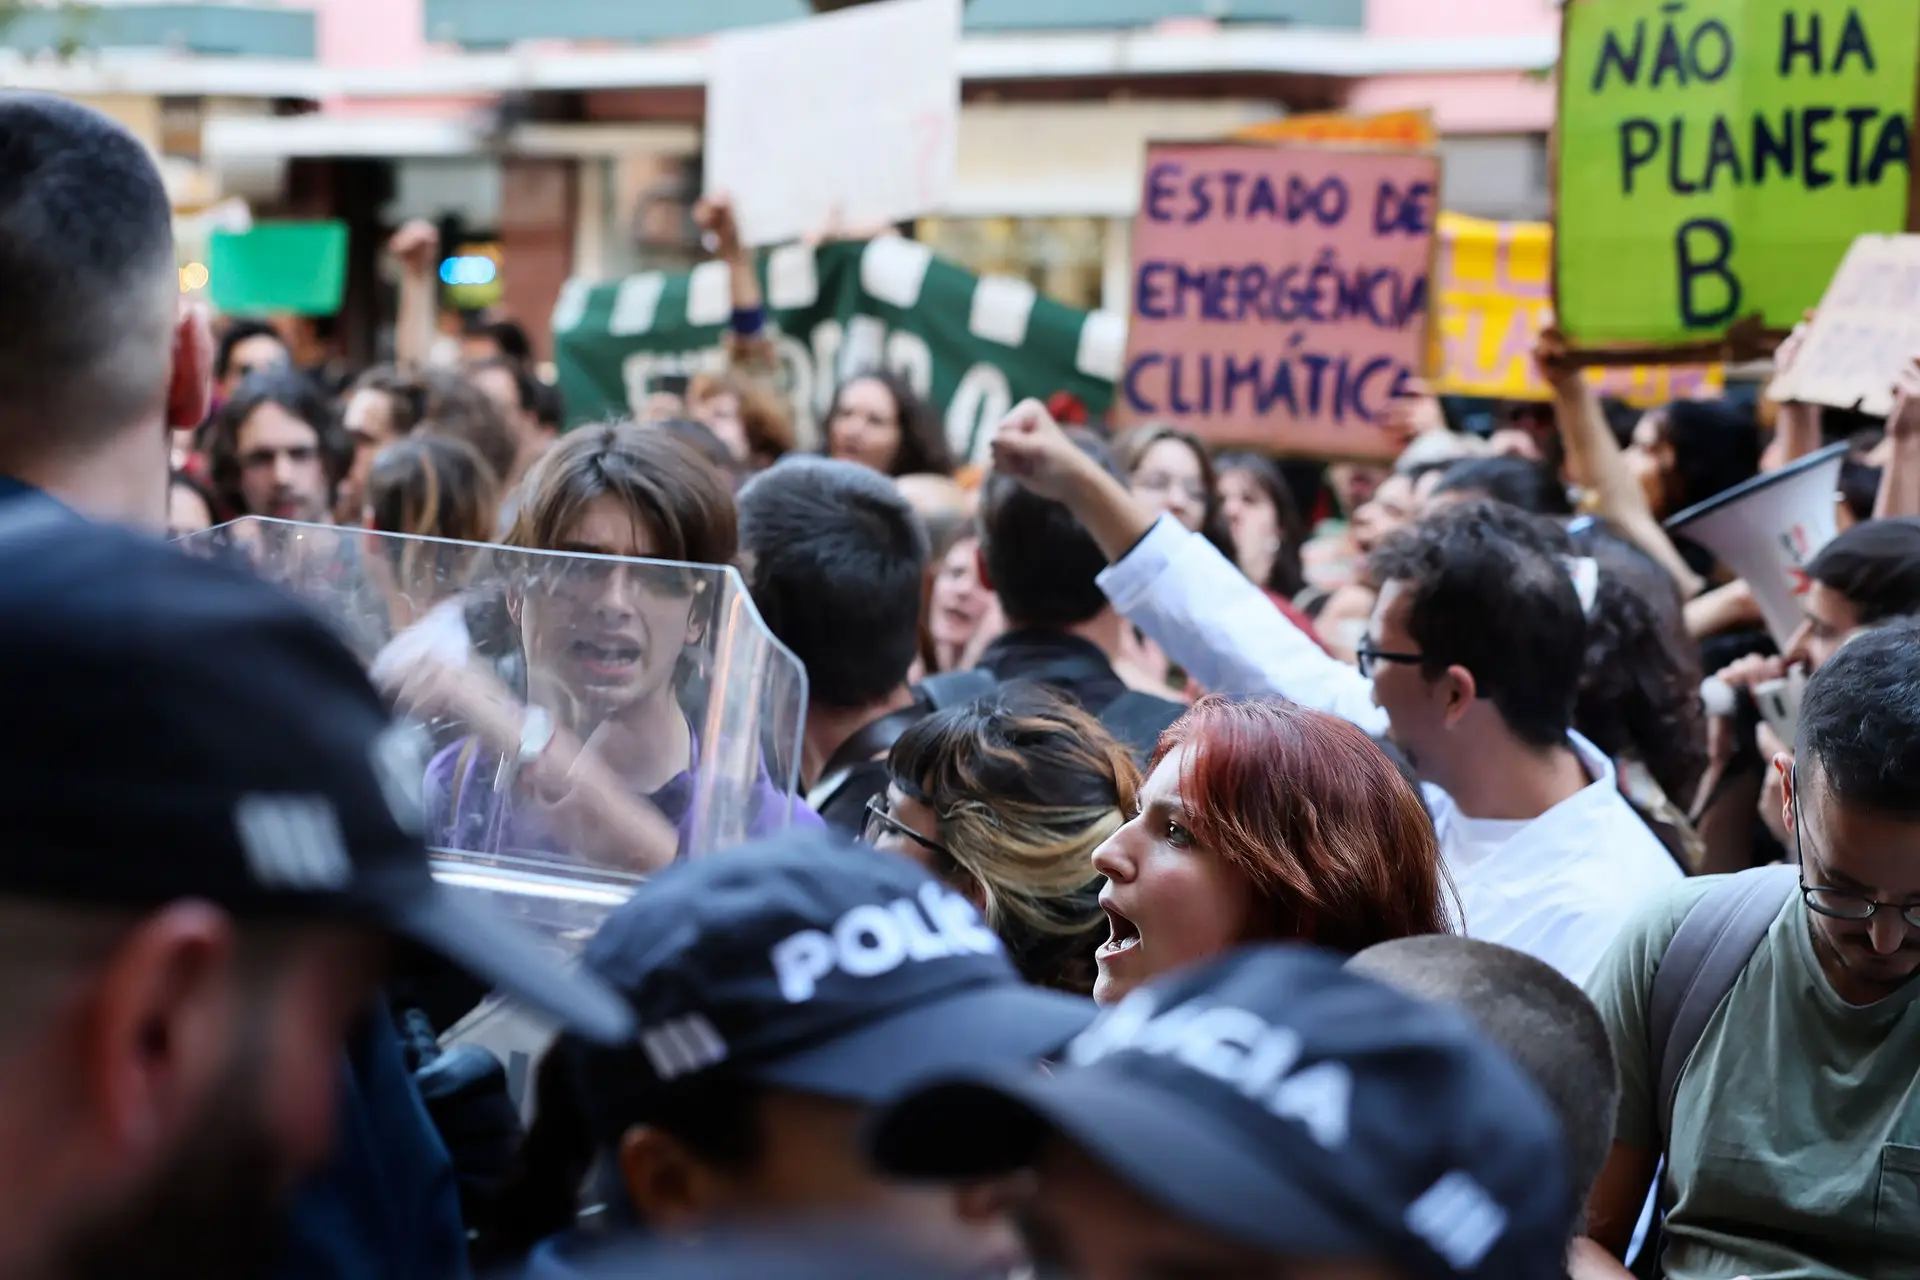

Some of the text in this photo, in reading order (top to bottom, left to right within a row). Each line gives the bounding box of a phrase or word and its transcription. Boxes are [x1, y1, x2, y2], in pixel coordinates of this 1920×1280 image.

[1590, 1, 1735, 92] NÃO
[1618, 105, 1911, 195] PLANETA
[1147, 163, 1432, 236] ESTADO DE
[1675, 216, 1741, 329] B
